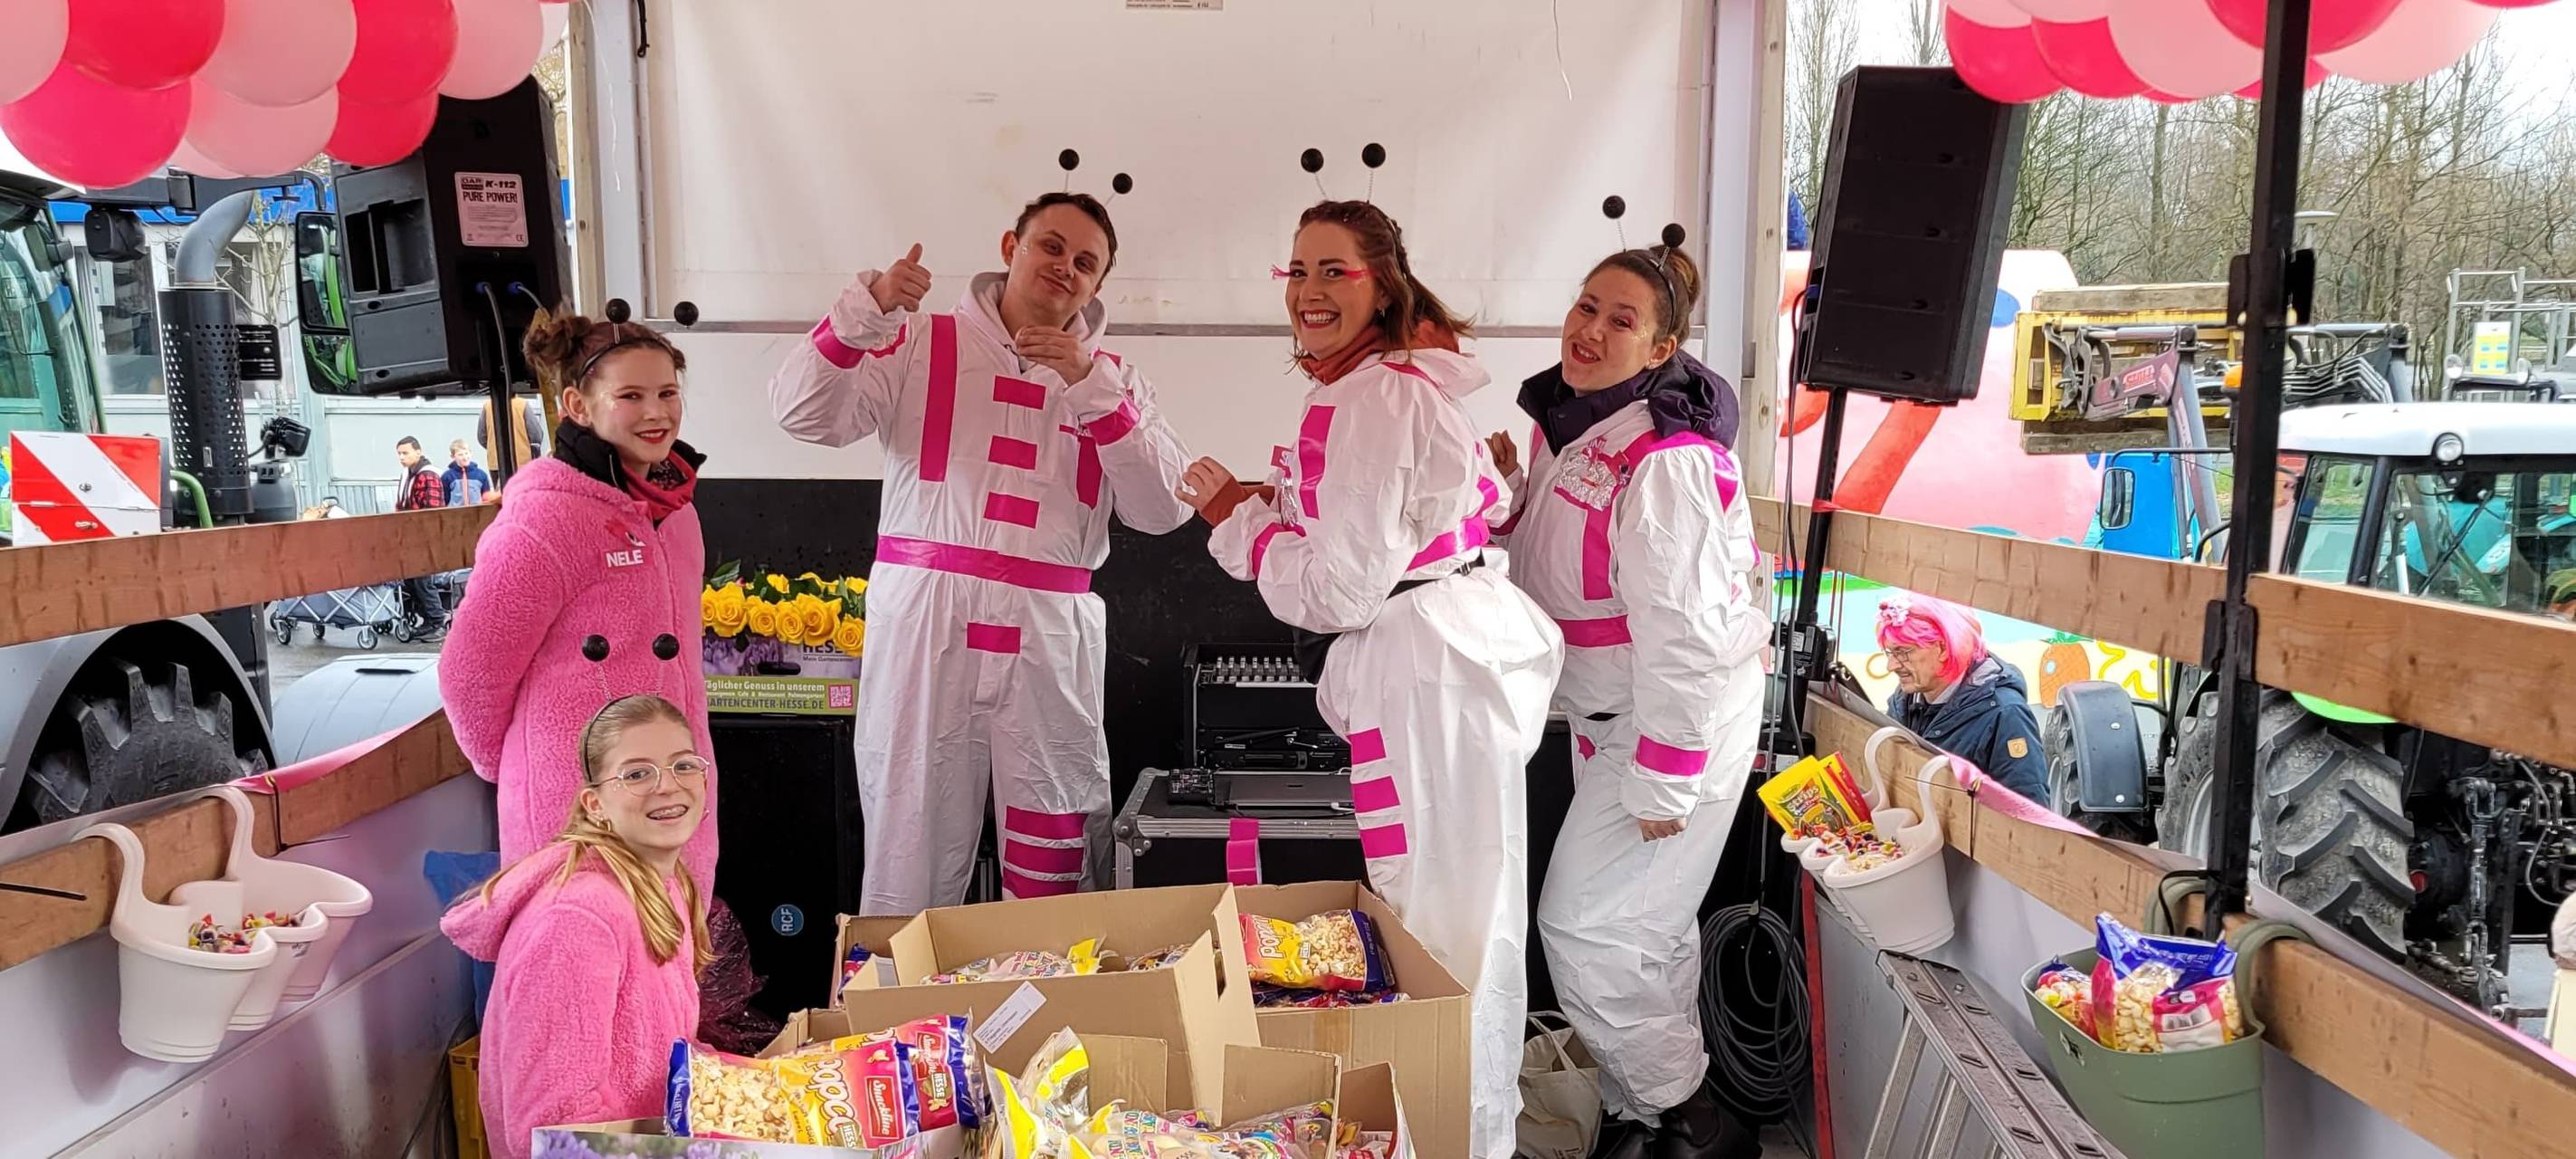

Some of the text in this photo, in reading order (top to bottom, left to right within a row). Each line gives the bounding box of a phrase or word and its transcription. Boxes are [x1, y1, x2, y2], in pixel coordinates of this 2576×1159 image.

[485, 180, 516, 188] K-112
[463, 191, 519, 204] PURE POWER!
[606, 549, 644, 568] NELE
[743, 680, 776, 691] Genuss
[777, 681, 786, 691] in
[787, 683, 825, 692] unserem
[707, 697, 825, 710] ARTENCENTER-HESSE.DE
[780, 907, 794, 932] RCF
[933, 1073, 945, 1097] HESSE
[873, 1079, 892, 1135] Snackline
[843, 1125, 856, 1148] HESS
